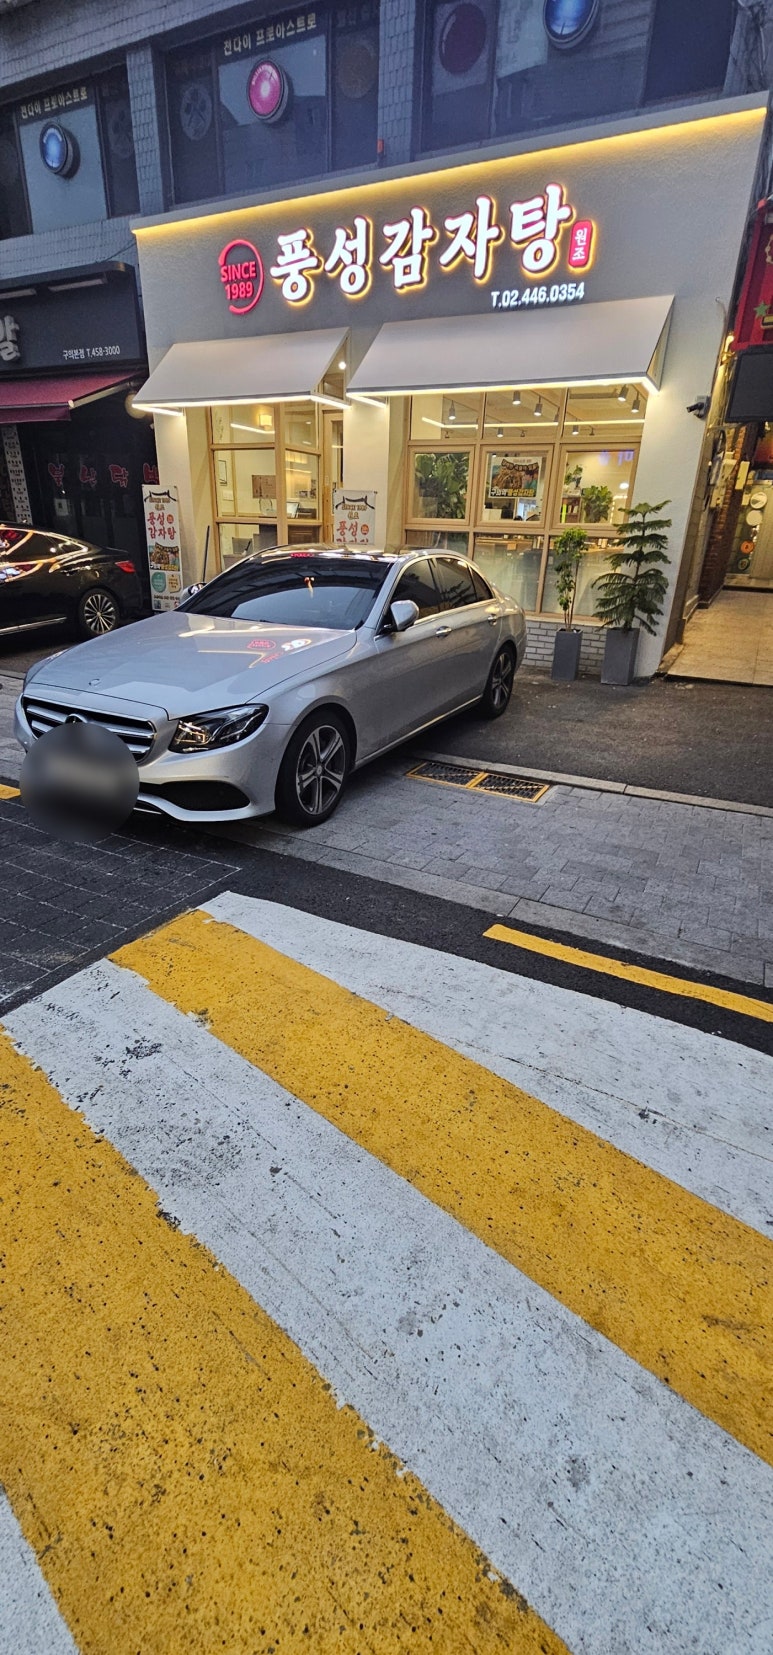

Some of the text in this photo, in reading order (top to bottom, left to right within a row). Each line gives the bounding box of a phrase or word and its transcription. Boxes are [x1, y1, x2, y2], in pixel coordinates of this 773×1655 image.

[223, 34, 251, 56] 전다이
[255, 12, 317, 46] 프로아스트로
[44, 86, 88, 112] 프로아스트로
[269, 182, 573, 303] 풍성감자탕
[571, 227, 588, 261] 원조
[219, 260, 257, 284] SINCE
[225, 280, 254, 301] 1989
[490, 281, 585, 308] T.02.446.0354
[63, 348, 86, 361] 구의본점
[147, 511, 165, 526] 풍성
[336, 520, 358, 537] 풍성
[148, 525, 177, 541] 감자탕
